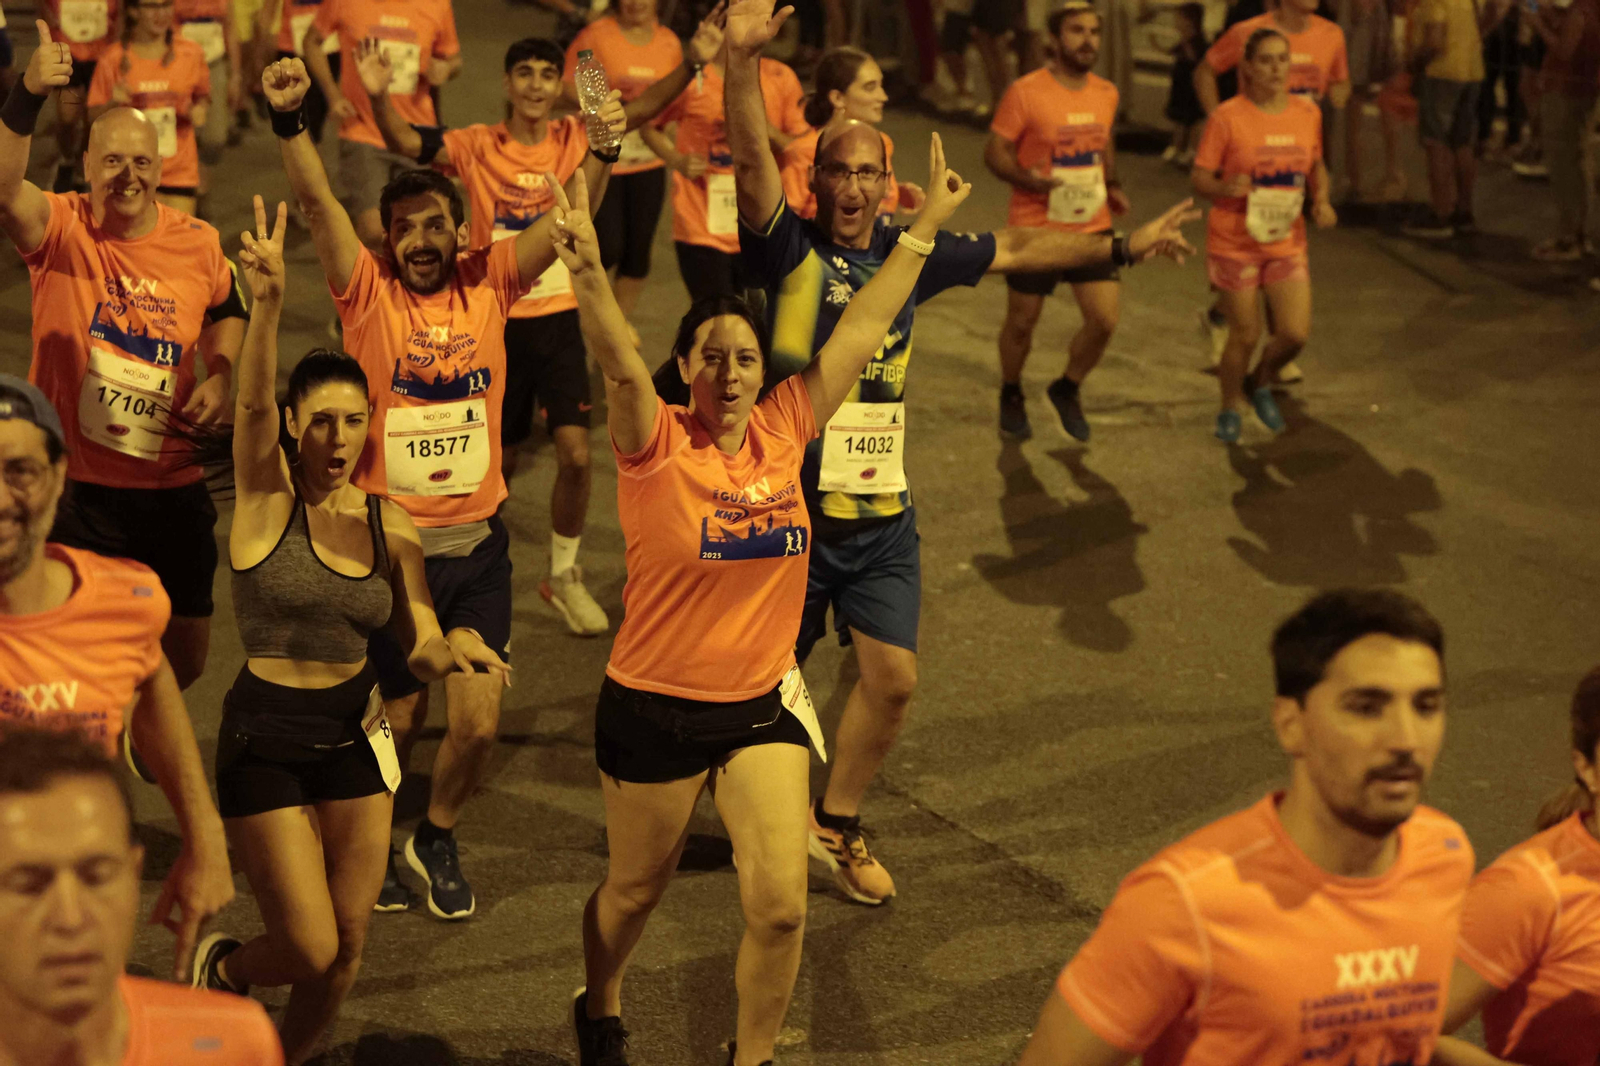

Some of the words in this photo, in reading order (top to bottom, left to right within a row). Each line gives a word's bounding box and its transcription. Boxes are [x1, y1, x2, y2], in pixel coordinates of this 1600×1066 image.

[517, 172, 547, 188] XXX
[406, 352, 430, 365] KH7
[97, 385, 157, 420] 17104
[406, 434, 471, 458] 18577
[845, 435, 894, 455] 14032
[714, 509, 743, 522] KH7
[1334, 943, 1420, 989] XXXV
